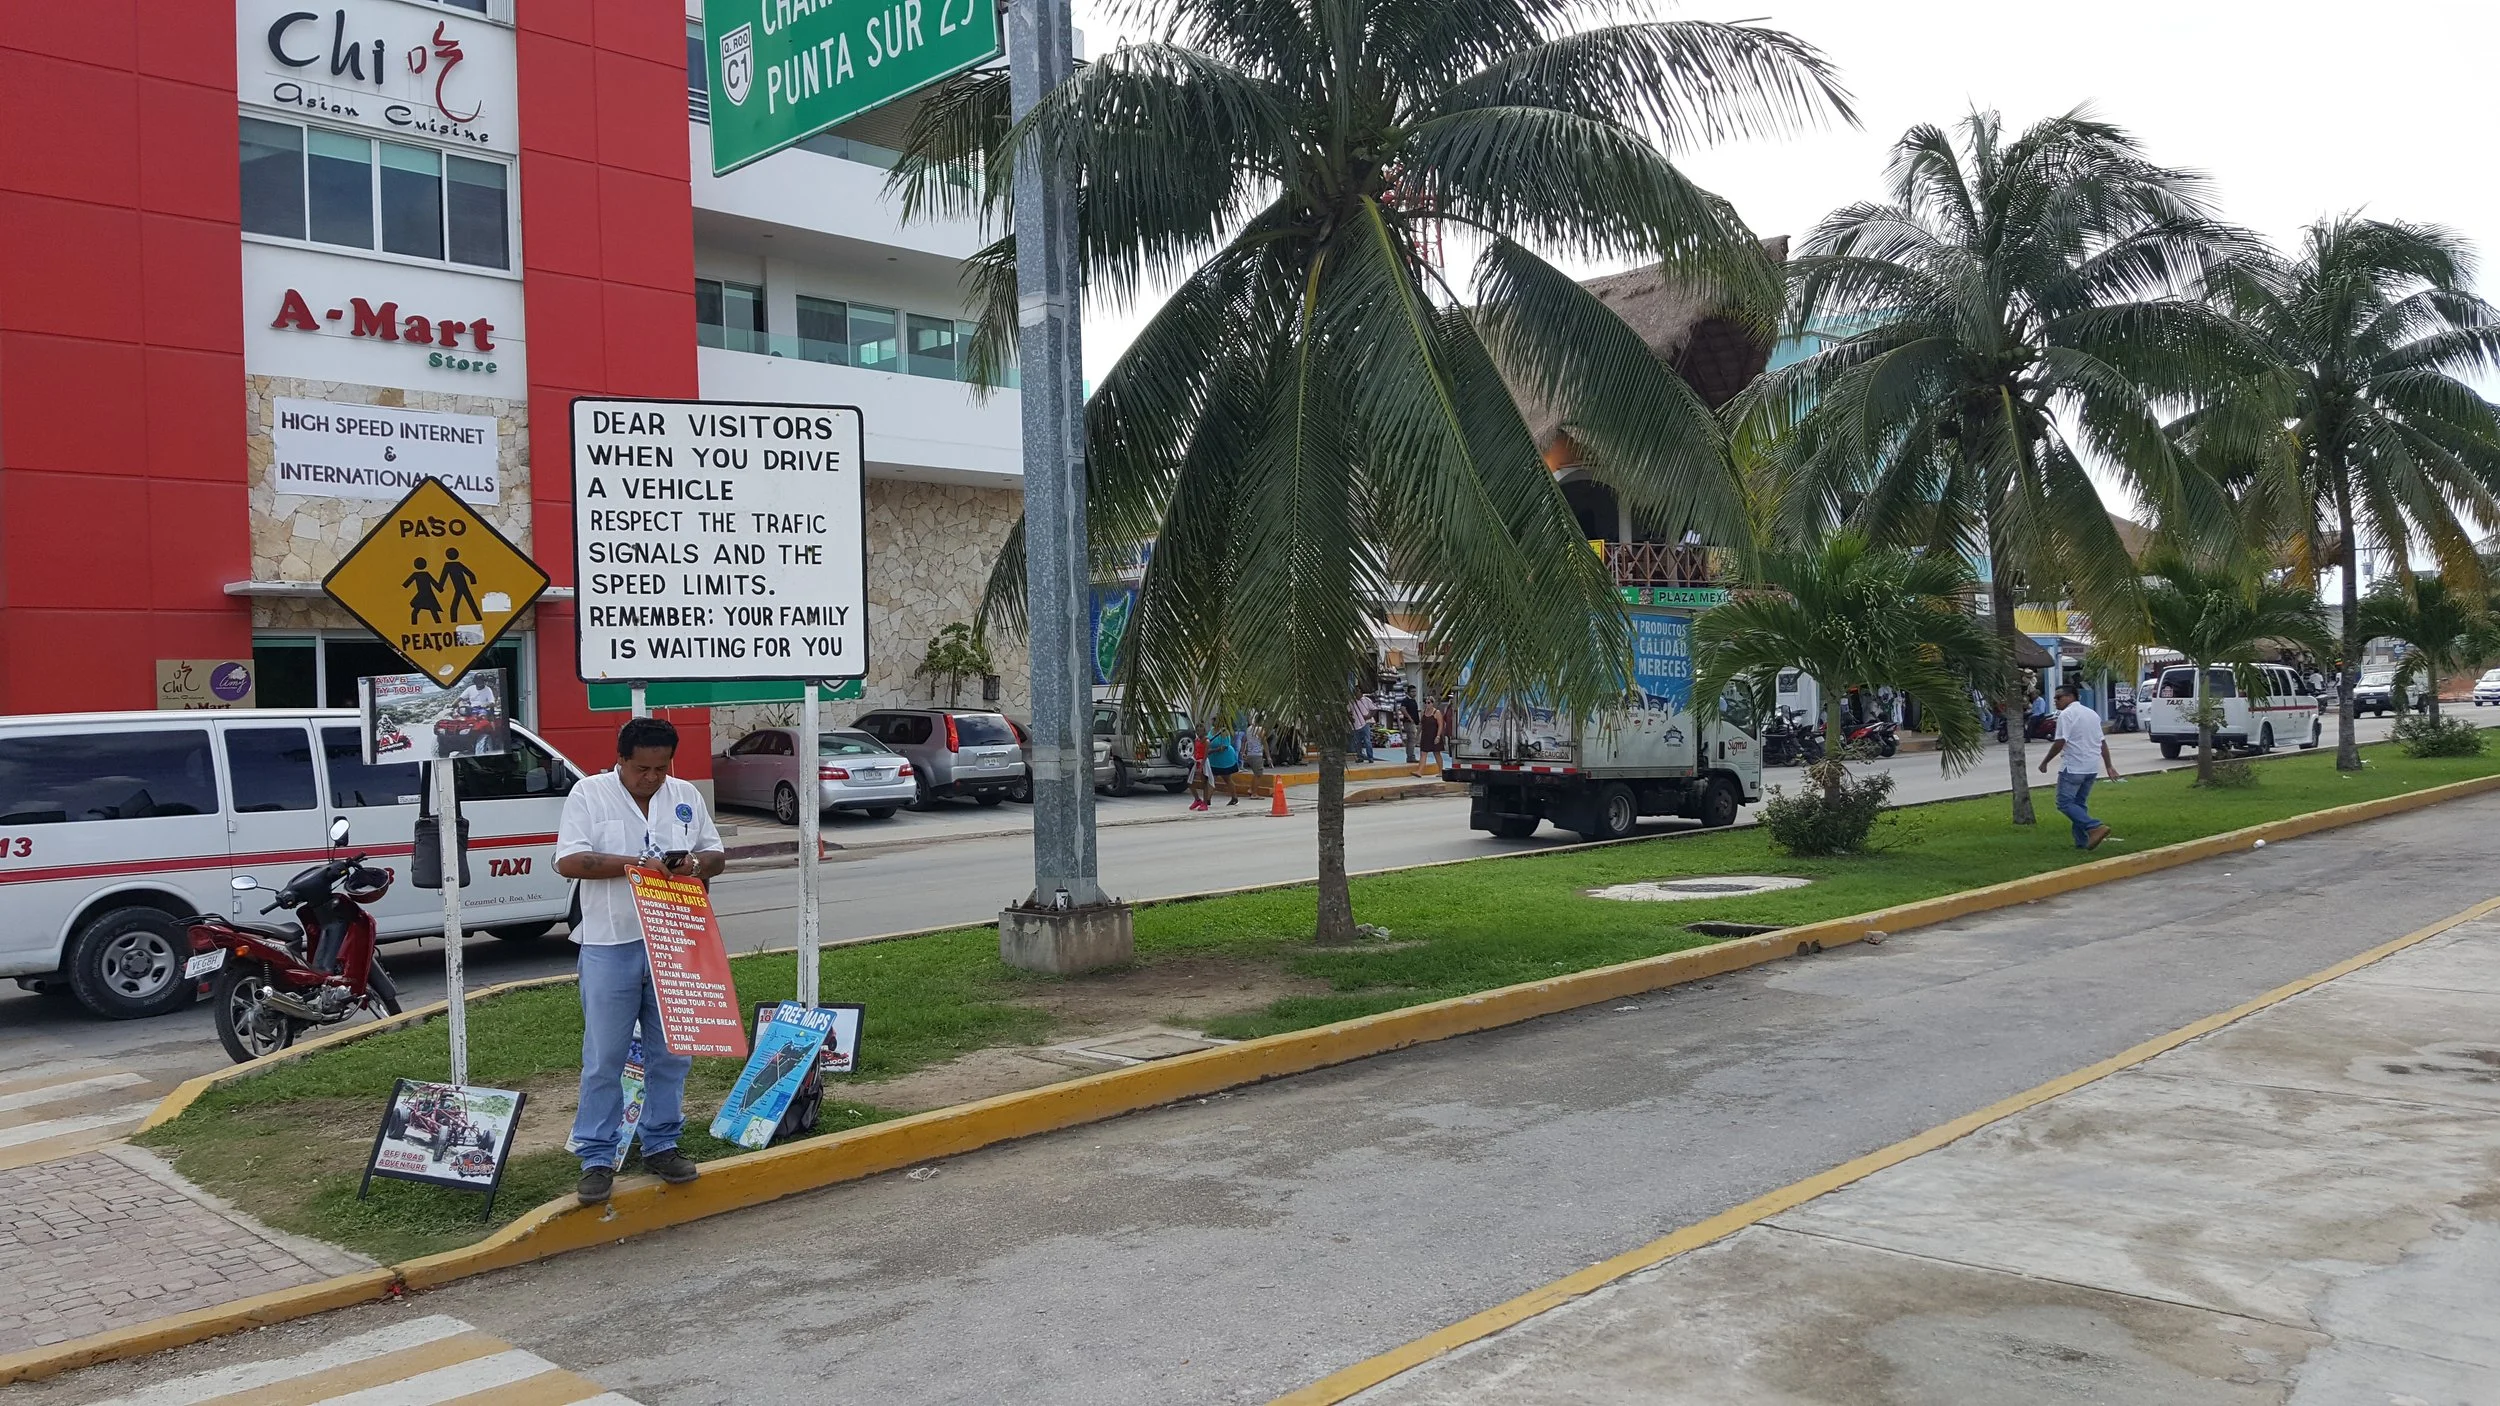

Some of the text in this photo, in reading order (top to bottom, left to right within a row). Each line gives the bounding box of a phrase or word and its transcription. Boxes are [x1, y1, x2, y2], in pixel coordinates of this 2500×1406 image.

[267, 9, 386, 86] Chi
[733, 33, 749, 50] ROO
[767, 32, 855, 114] PUNTA
[866, 0, 924, 68] SUR
[727, 53, 749, 89] C1
[385, 105, 489, 144] Cuisine
[271, 288, 495, 352] A-Mart
[428, 352, 498, 374] Store
[281, 411, 485, 445] HIGH SPEED INTERNET
[593, 411, 832, 440] DEAR VISITORS
[384, 446, 397, 462] &
[587, 444, 840, 471] WHEN YOU DRIVE
[280, 462, 495, 493] INTERNATIONA CALLS
[587, 477, 733, 500] A VEHICLE
[400, 518, 467, 538] PASO
[591, 510, 827, 533] RESPECT THE TRAFIC
[589, 542, 822, 565] SIGNALS AND THE
[592, 574, 776, 596] SPEED LIMITS.
[1659, 592, 1696, 602] PLAZA
[590, 606, 849, 627] REMEMBER: YOUR FAMILY
[1640, 620, 1686, 636] PRODUCTOS
[611, 636, 842, 659] IS WAITING FOR YOU
[1638, 657, 1687, 677] MERECES
[393, 686, 421, 694] TOUR
[1728, 739, 1748, 756] Sigma
[488, 857, 532, 877] TAXI
[643, 876, 703, 894] UNION WORKERS
[635, 886, 707, 908] DISCOUNTS RATES
[641, 900, 670, 910] SNORKEL
[644, 908, 706, 923] GLASS BOTTOM BOAT
[649, 925, 669, 934] SCUBA
[679, 922, 705, 931] FISHING
[651, 934, 696, 946] SCUBA LESSON
[653, 942, 669, 950] PARA
[658, 970, 680, 978] MAYAN
[685, 989, 702, 997] BACK
[703, 991, 724, 999] RIDING
[696, 982, 726, 991] DOLPHINS
[664, 997, 688, 1005] ISLAND
[689, 998, 706, 1007] TOUR
[672, 1007, 694, 1015] HOURS
[776, 1004, 831, 1032] FREE MAPS
[668, 1015, 682, 1023] ALL
[695, 1017, 716, 1025] BEACH
[716, 1018, 737, 1026] BREAK
[684, 1025, 700, 1033] PASS
[674, 1043, 692, 1051] DUNE
[693, 1044, 714, 1052] BUGGY
[383, 1149, 425, 1161] OFF ROAD
[378, 1158, 427, 1172] ADVENTURE
